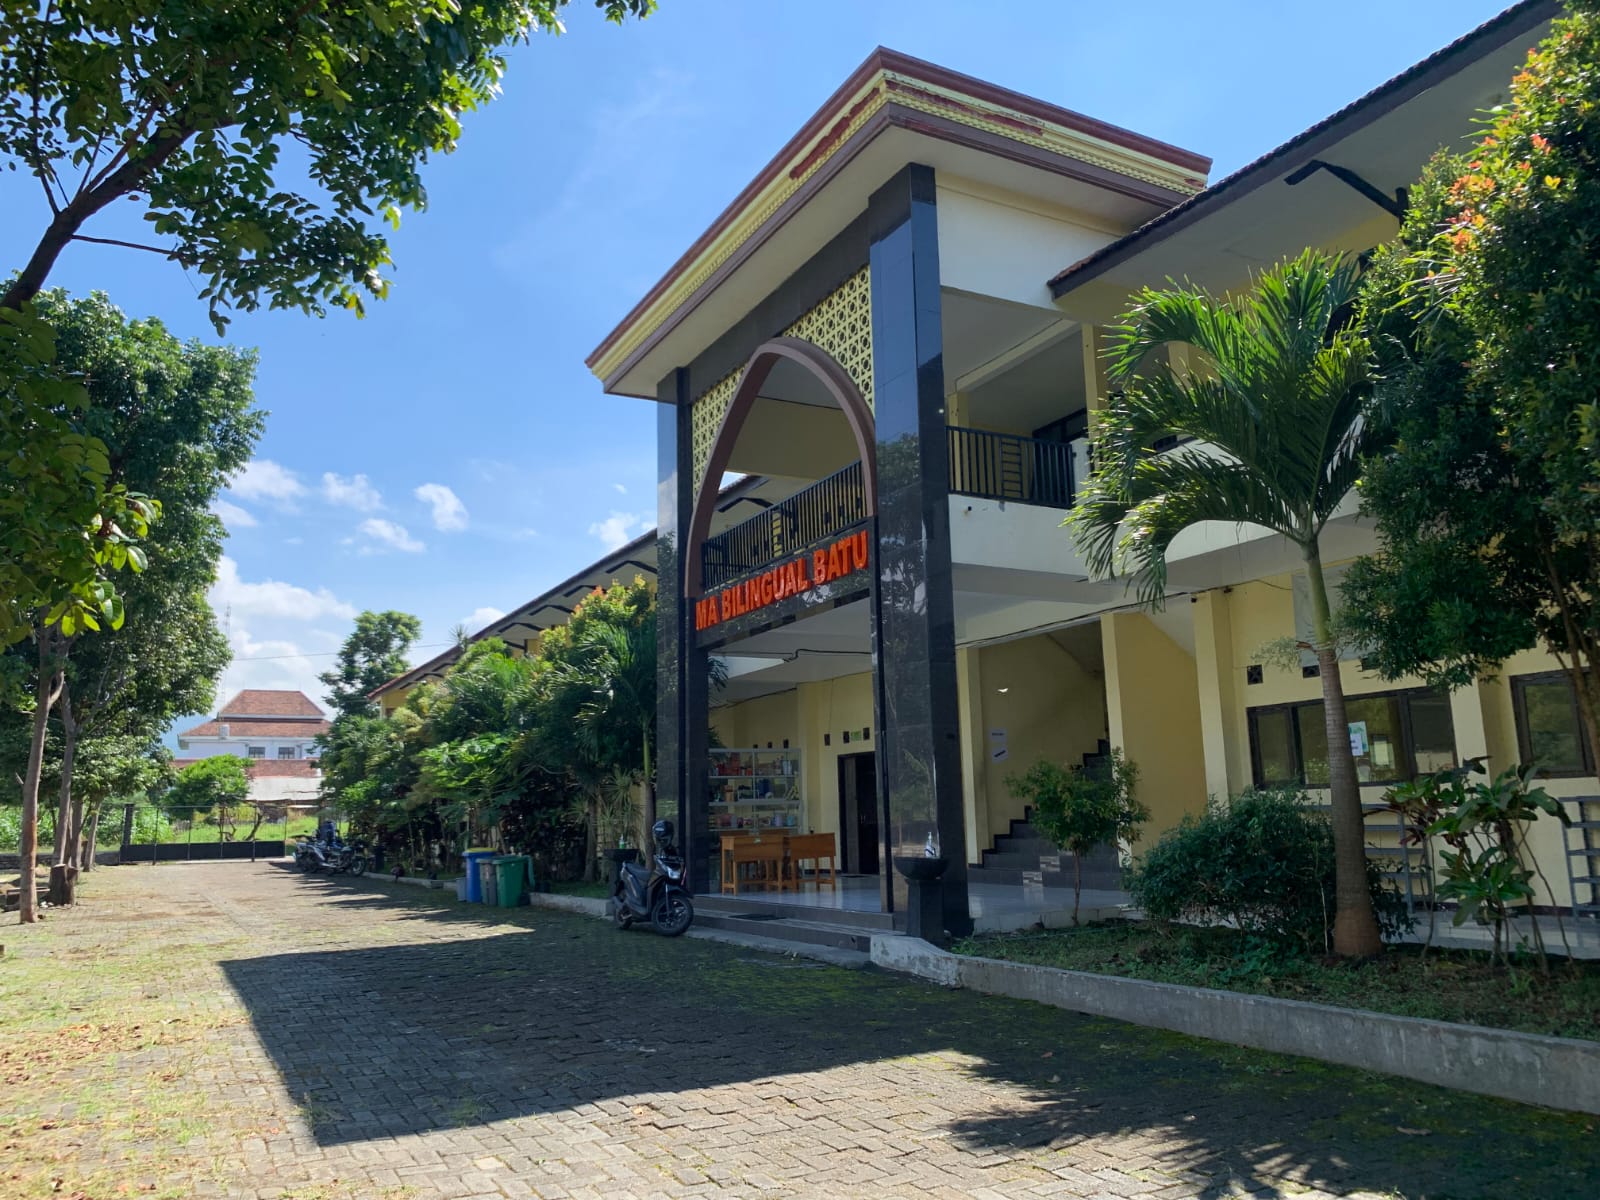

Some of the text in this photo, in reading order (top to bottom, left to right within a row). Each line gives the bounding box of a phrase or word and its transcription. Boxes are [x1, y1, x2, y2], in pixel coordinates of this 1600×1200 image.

[695, 530, 868, 630] MA BILINGUAL BATU
